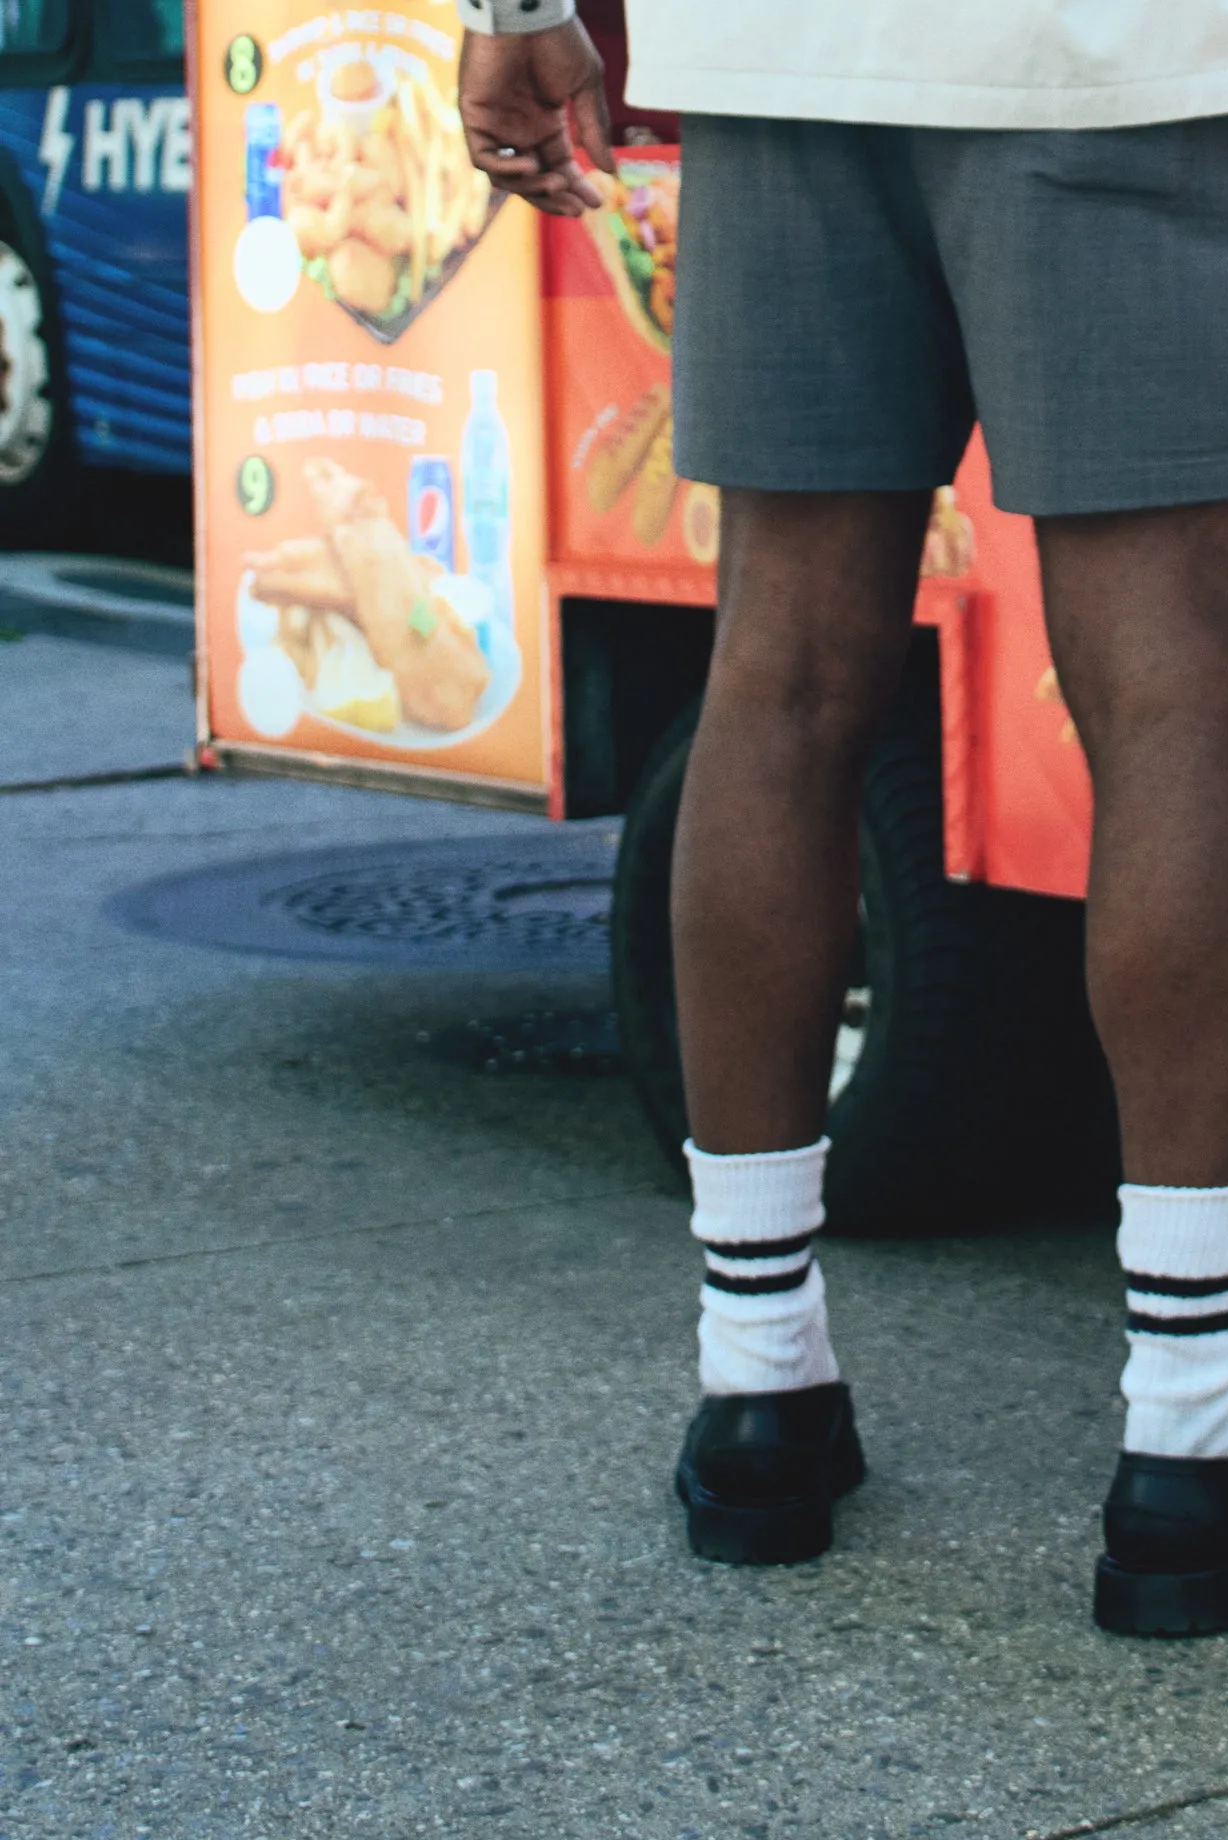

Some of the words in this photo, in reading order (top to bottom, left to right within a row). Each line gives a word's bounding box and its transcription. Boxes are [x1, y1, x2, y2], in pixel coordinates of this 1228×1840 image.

[229, 34, 258, 94] 8
[386, 365, 444, 407] FRIES
[358, 411, 427, 447] WATER
[241, 455, 269, 517] 9
